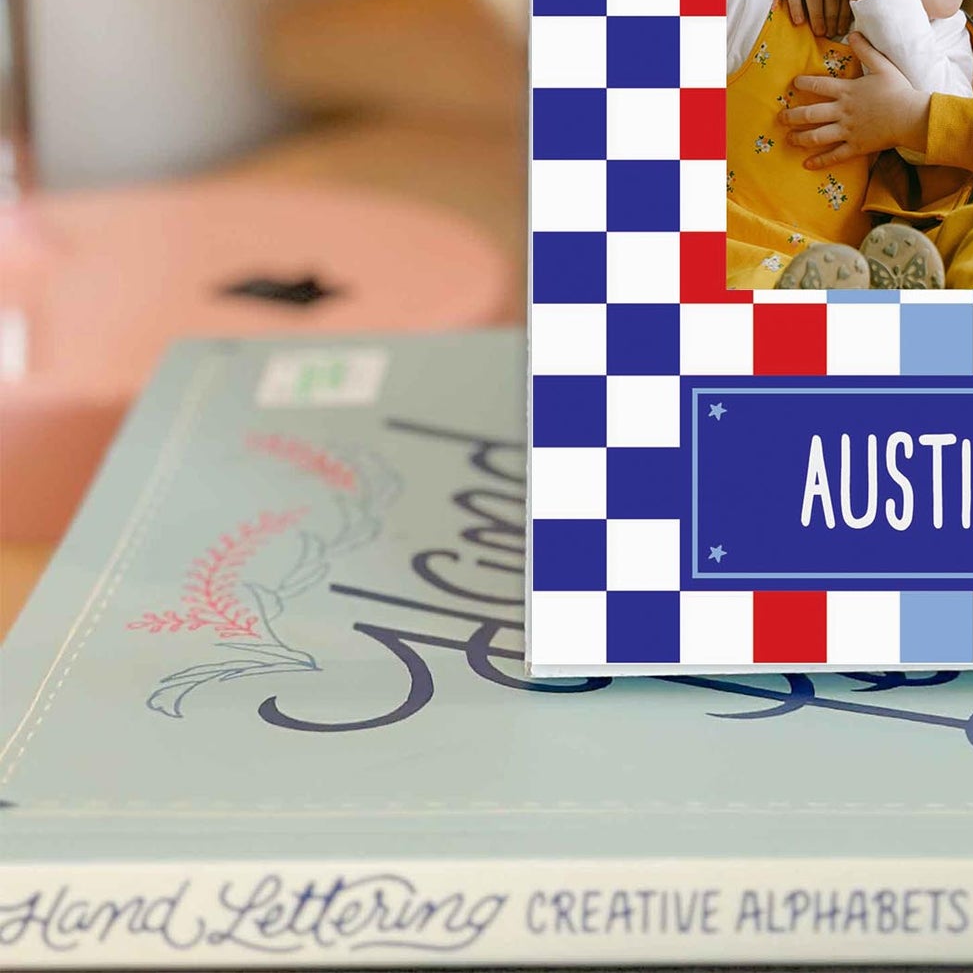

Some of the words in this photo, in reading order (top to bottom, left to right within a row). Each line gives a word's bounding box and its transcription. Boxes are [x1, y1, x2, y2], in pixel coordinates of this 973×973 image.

[0, 879, 206, 953] Hand
[207, 873, 510, 953] Lettering
[526, 889, 721, 936] CREATIVE
[734, 889, 970, 935] ALPHABETS
